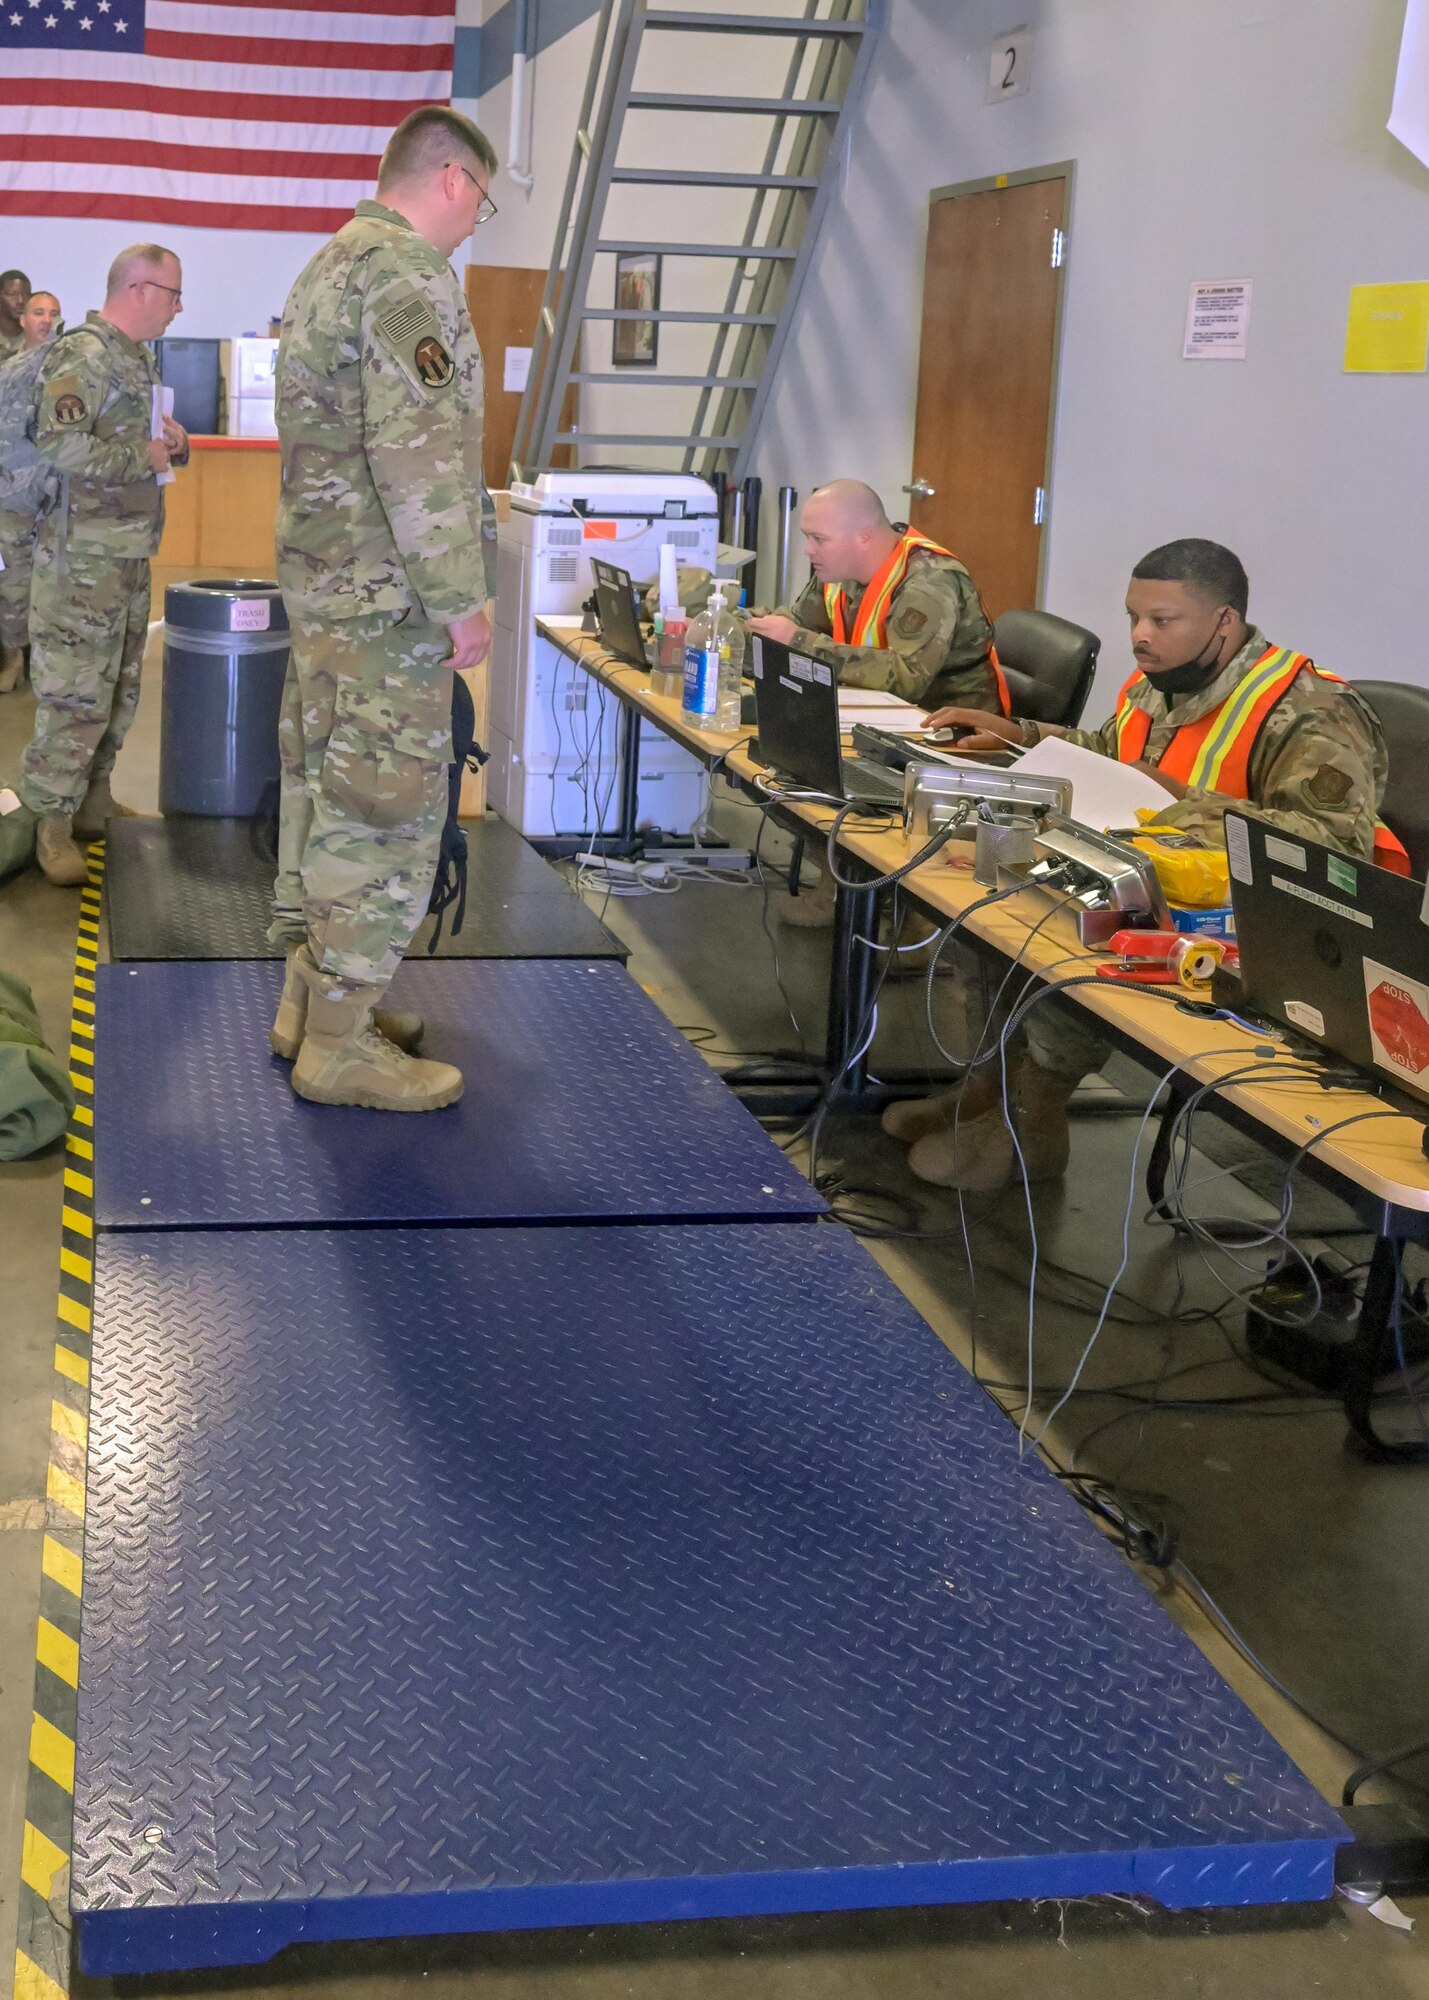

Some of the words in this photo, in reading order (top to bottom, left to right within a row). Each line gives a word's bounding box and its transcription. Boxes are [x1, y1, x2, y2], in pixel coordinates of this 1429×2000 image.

[1002, 47, 1016, 89] 2
[238, 609, 265, 617] TRASH
[237, 619, 259, 627] ONLY
[1318, 896, 1335, 910] ACCT
[1383, 984, 1411, 1005] STOP
[1391, 1051, 1418, 1073] STOP
